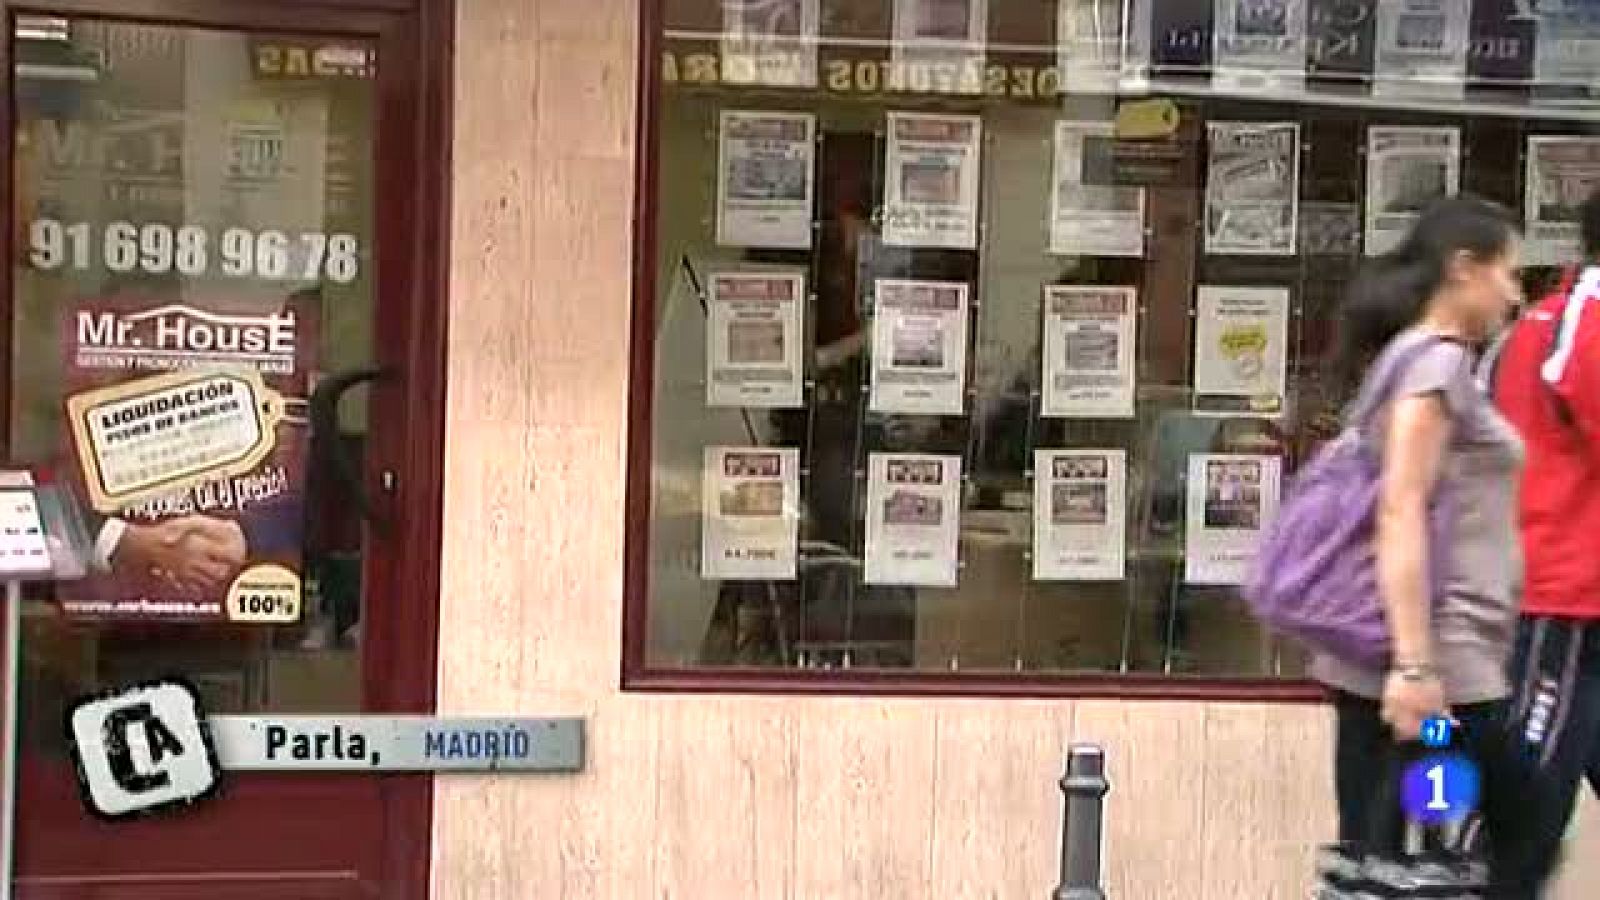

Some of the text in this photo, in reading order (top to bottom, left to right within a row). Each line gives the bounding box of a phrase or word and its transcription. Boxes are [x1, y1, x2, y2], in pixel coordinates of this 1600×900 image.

[30, 219, 358, 284] 91 698 96 78
[78, 311, 141, 345] Mr.
[102, 381, 233, 429] LIQUIDACIÓN
[238, 594, 296, 614] 100%
